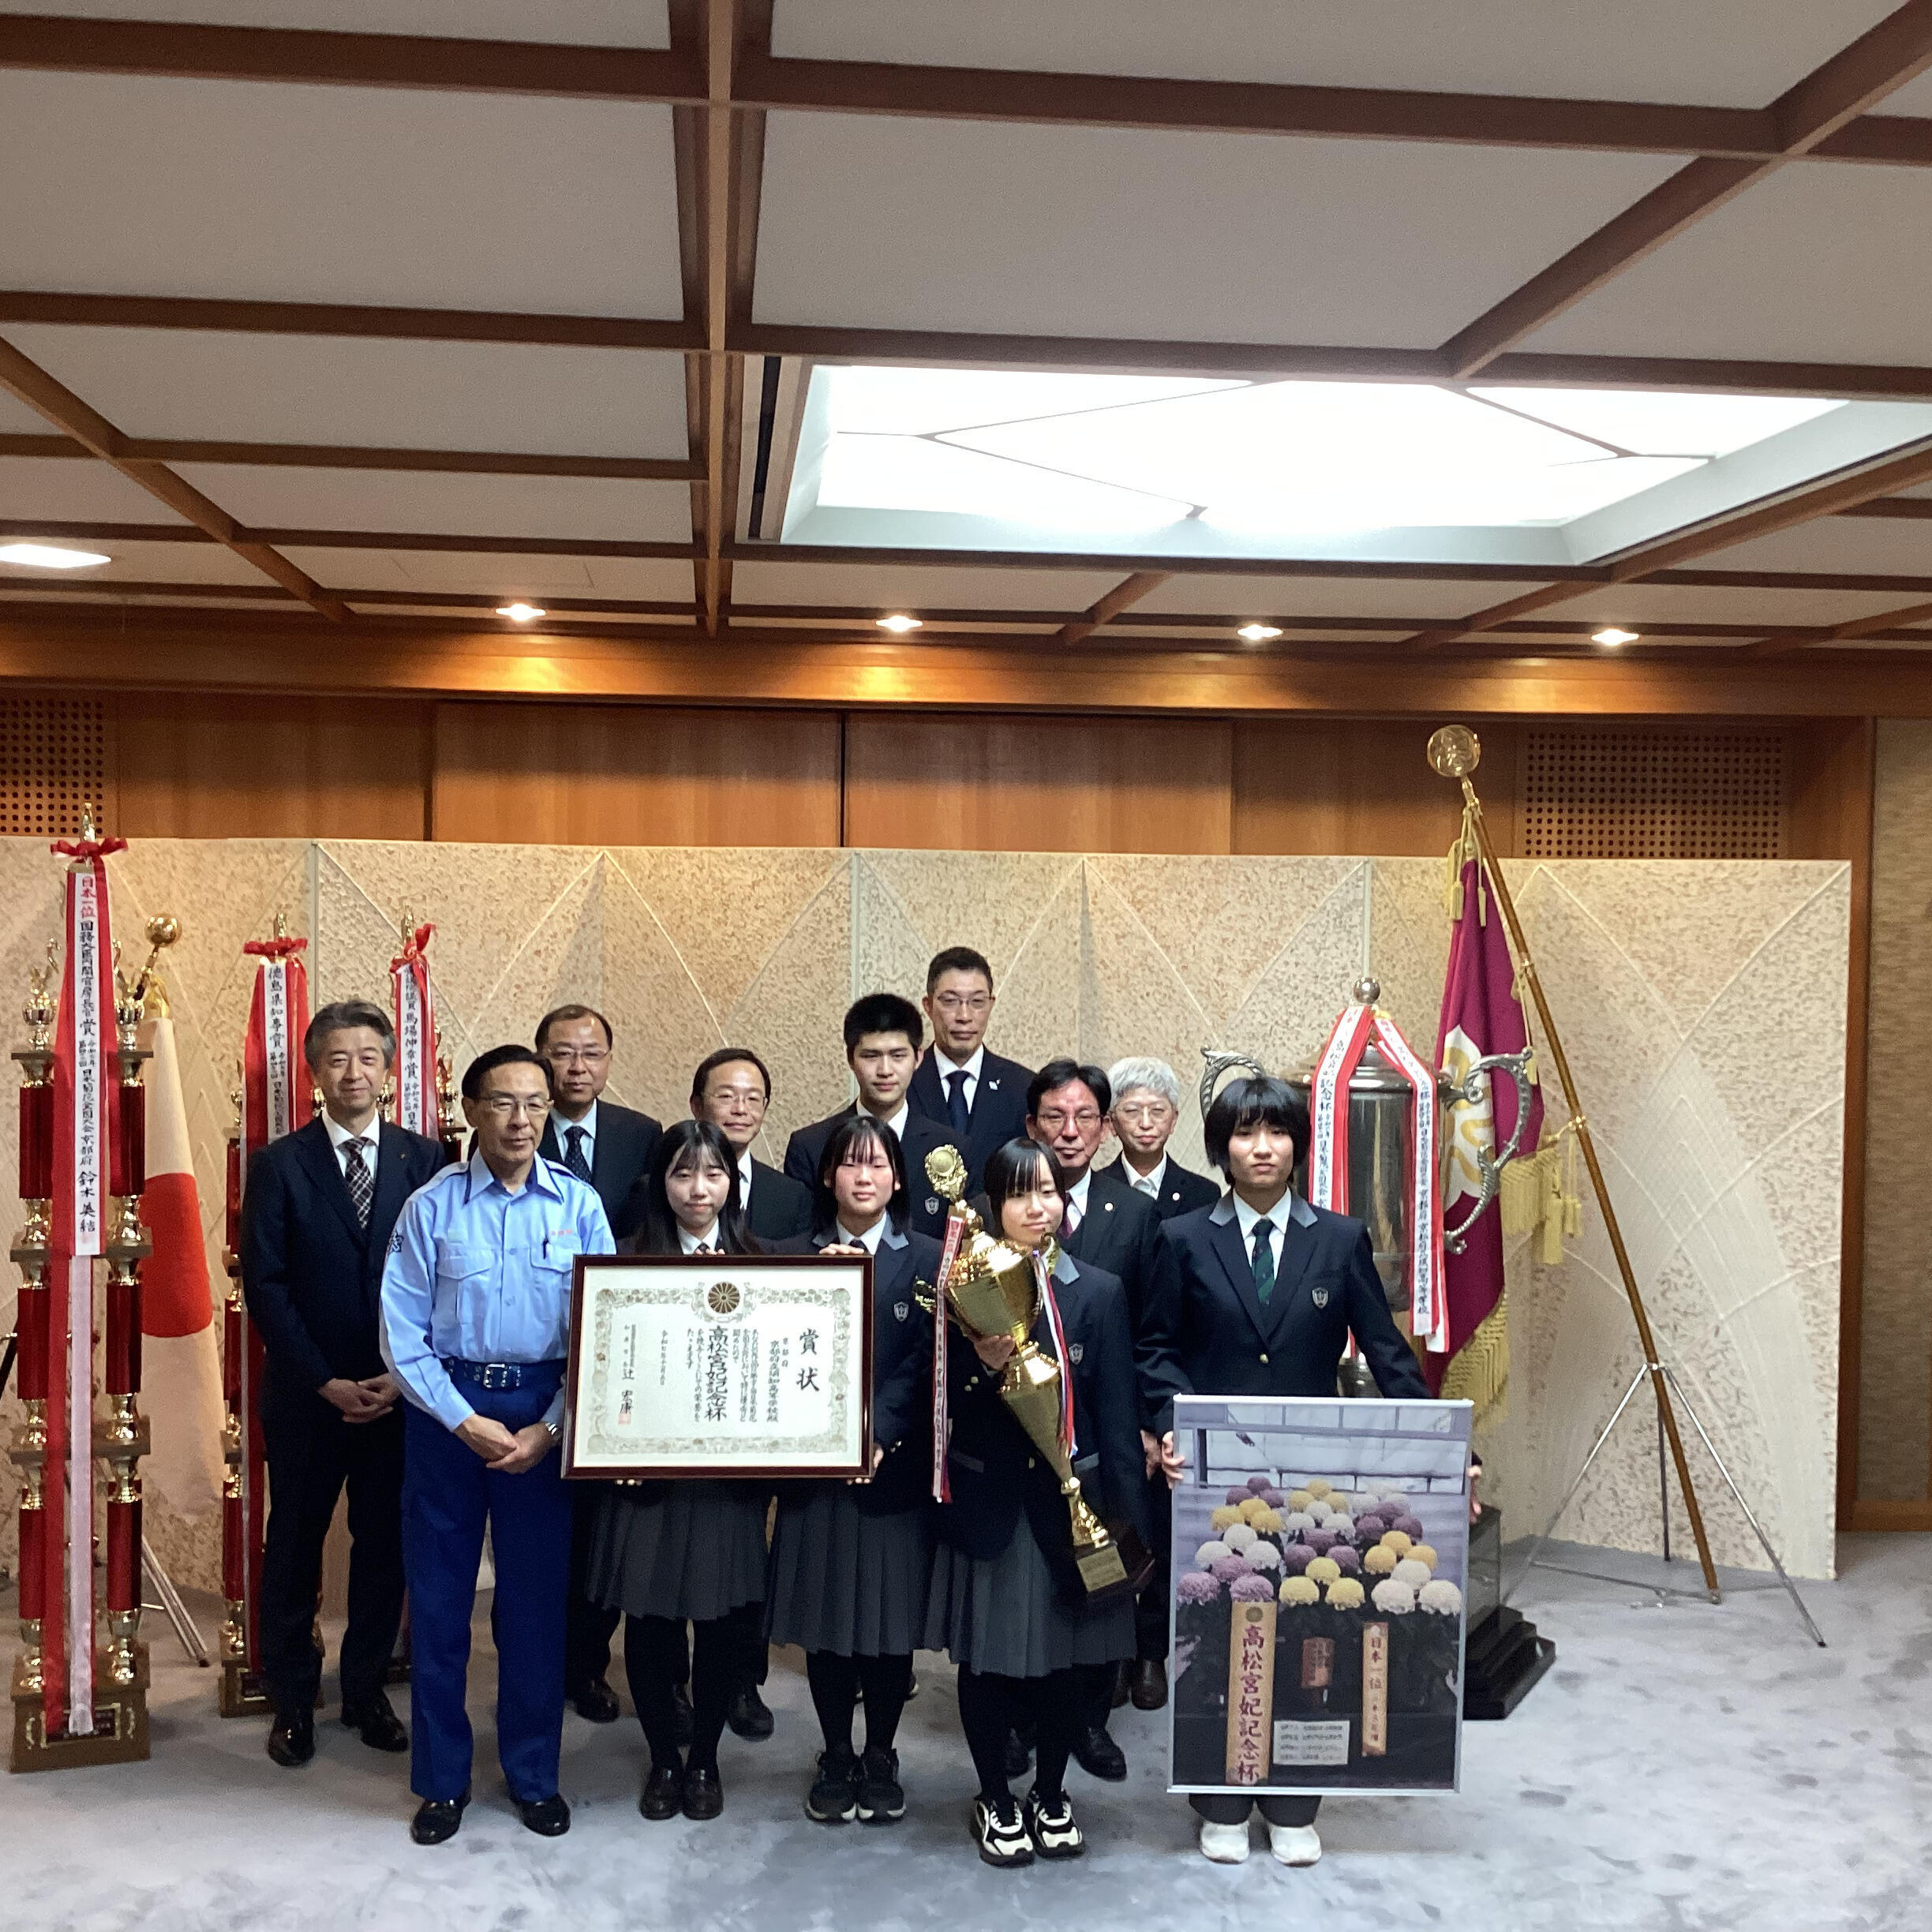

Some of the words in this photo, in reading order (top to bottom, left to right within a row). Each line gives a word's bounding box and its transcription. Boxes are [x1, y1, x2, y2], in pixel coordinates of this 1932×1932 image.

[705, 1325, 728, 1421] 高松宮妃記念杯
[1237, 1624, 1264, 1781] 高松宮妃記念杯
